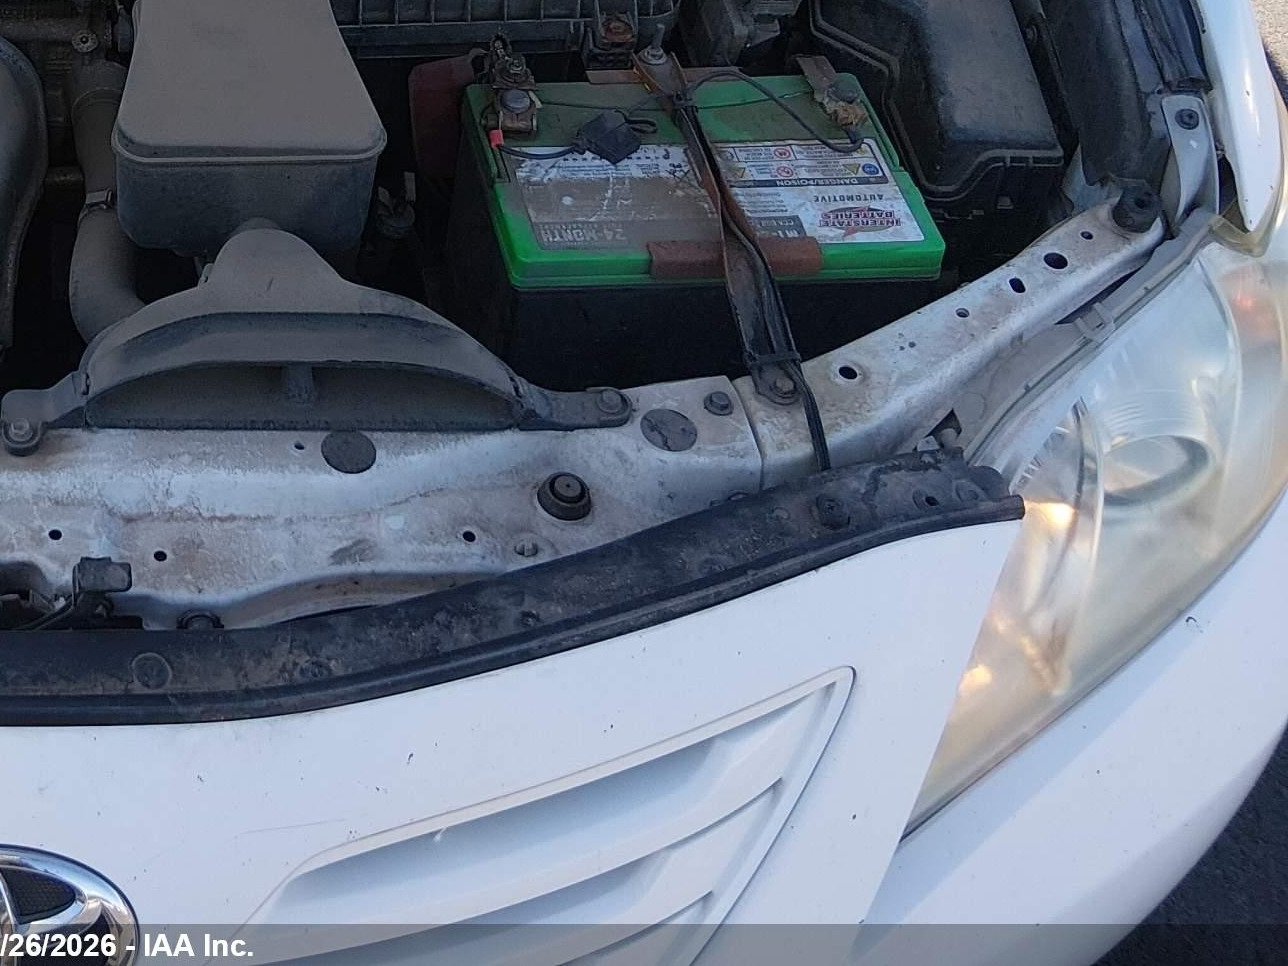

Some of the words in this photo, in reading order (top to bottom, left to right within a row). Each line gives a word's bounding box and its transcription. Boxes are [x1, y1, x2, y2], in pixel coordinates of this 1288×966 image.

[776, 178, 859, 187] DANGER/POISON
[813, 193, 884, 203] AUTOMOTIVE
[821, 210, 895, 220] BATTERIES
[818, 218, 901, 228] INTERSTATE
[541, 227, 627, 242] 24-MONTH
